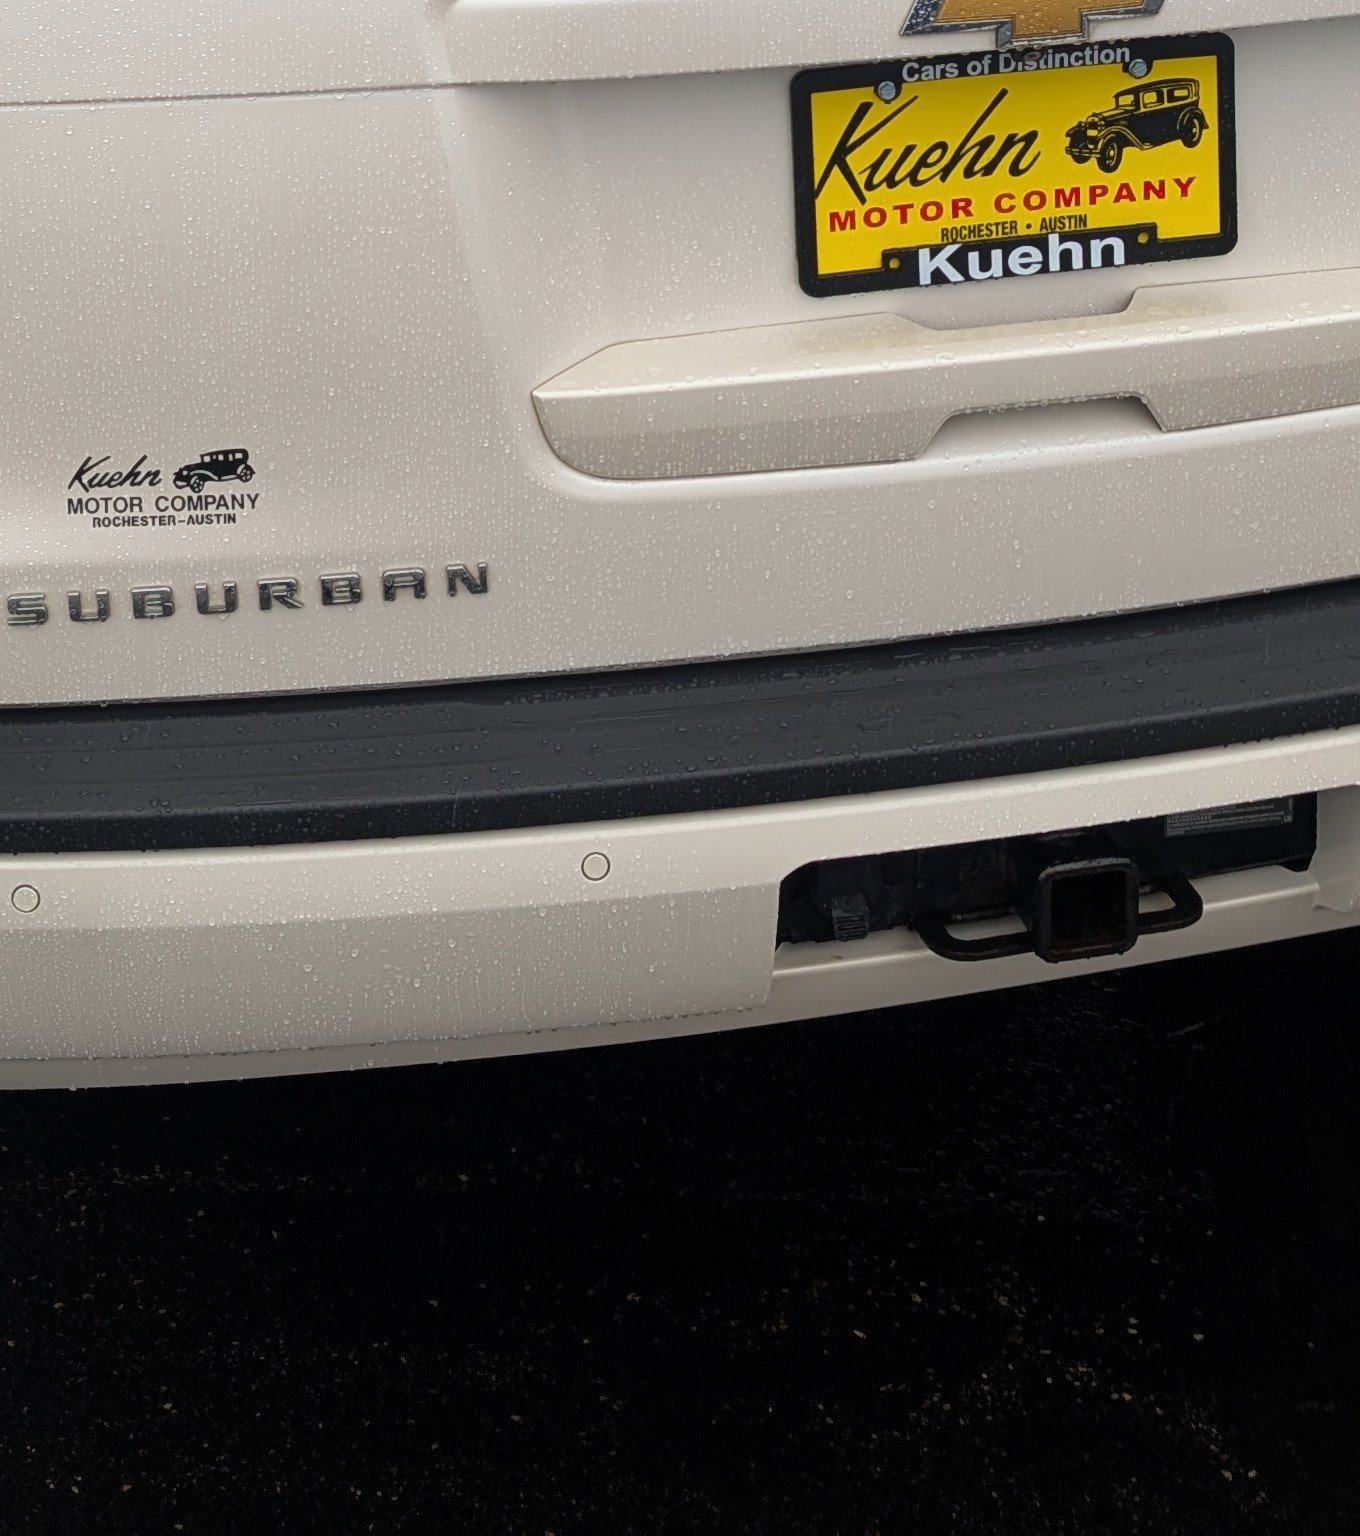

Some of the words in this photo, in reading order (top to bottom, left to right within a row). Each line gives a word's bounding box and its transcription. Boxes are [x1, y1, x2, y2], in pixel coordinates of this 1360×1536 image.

[901, 61, 959, 83] Cars
[966, 54, 992, 76] of
[814, 87, 1042, 205] Kuehn
[828, 197, 974, 233] MOTOR
[993, 176, 1198, 214] COMPANY
[940, 220, 1019, 243] ROCHESTER
[1039, 213, 1088, 232] AUSTIN
[917, 233, 1126, 287] Kuehn
[67, 454, 163, 494] Kuehn
[67, 496, 144, 515] MOTOR
[154, 492, 260, 513] COMPANY
[7, 562, 489, 626] SUBURBAN
